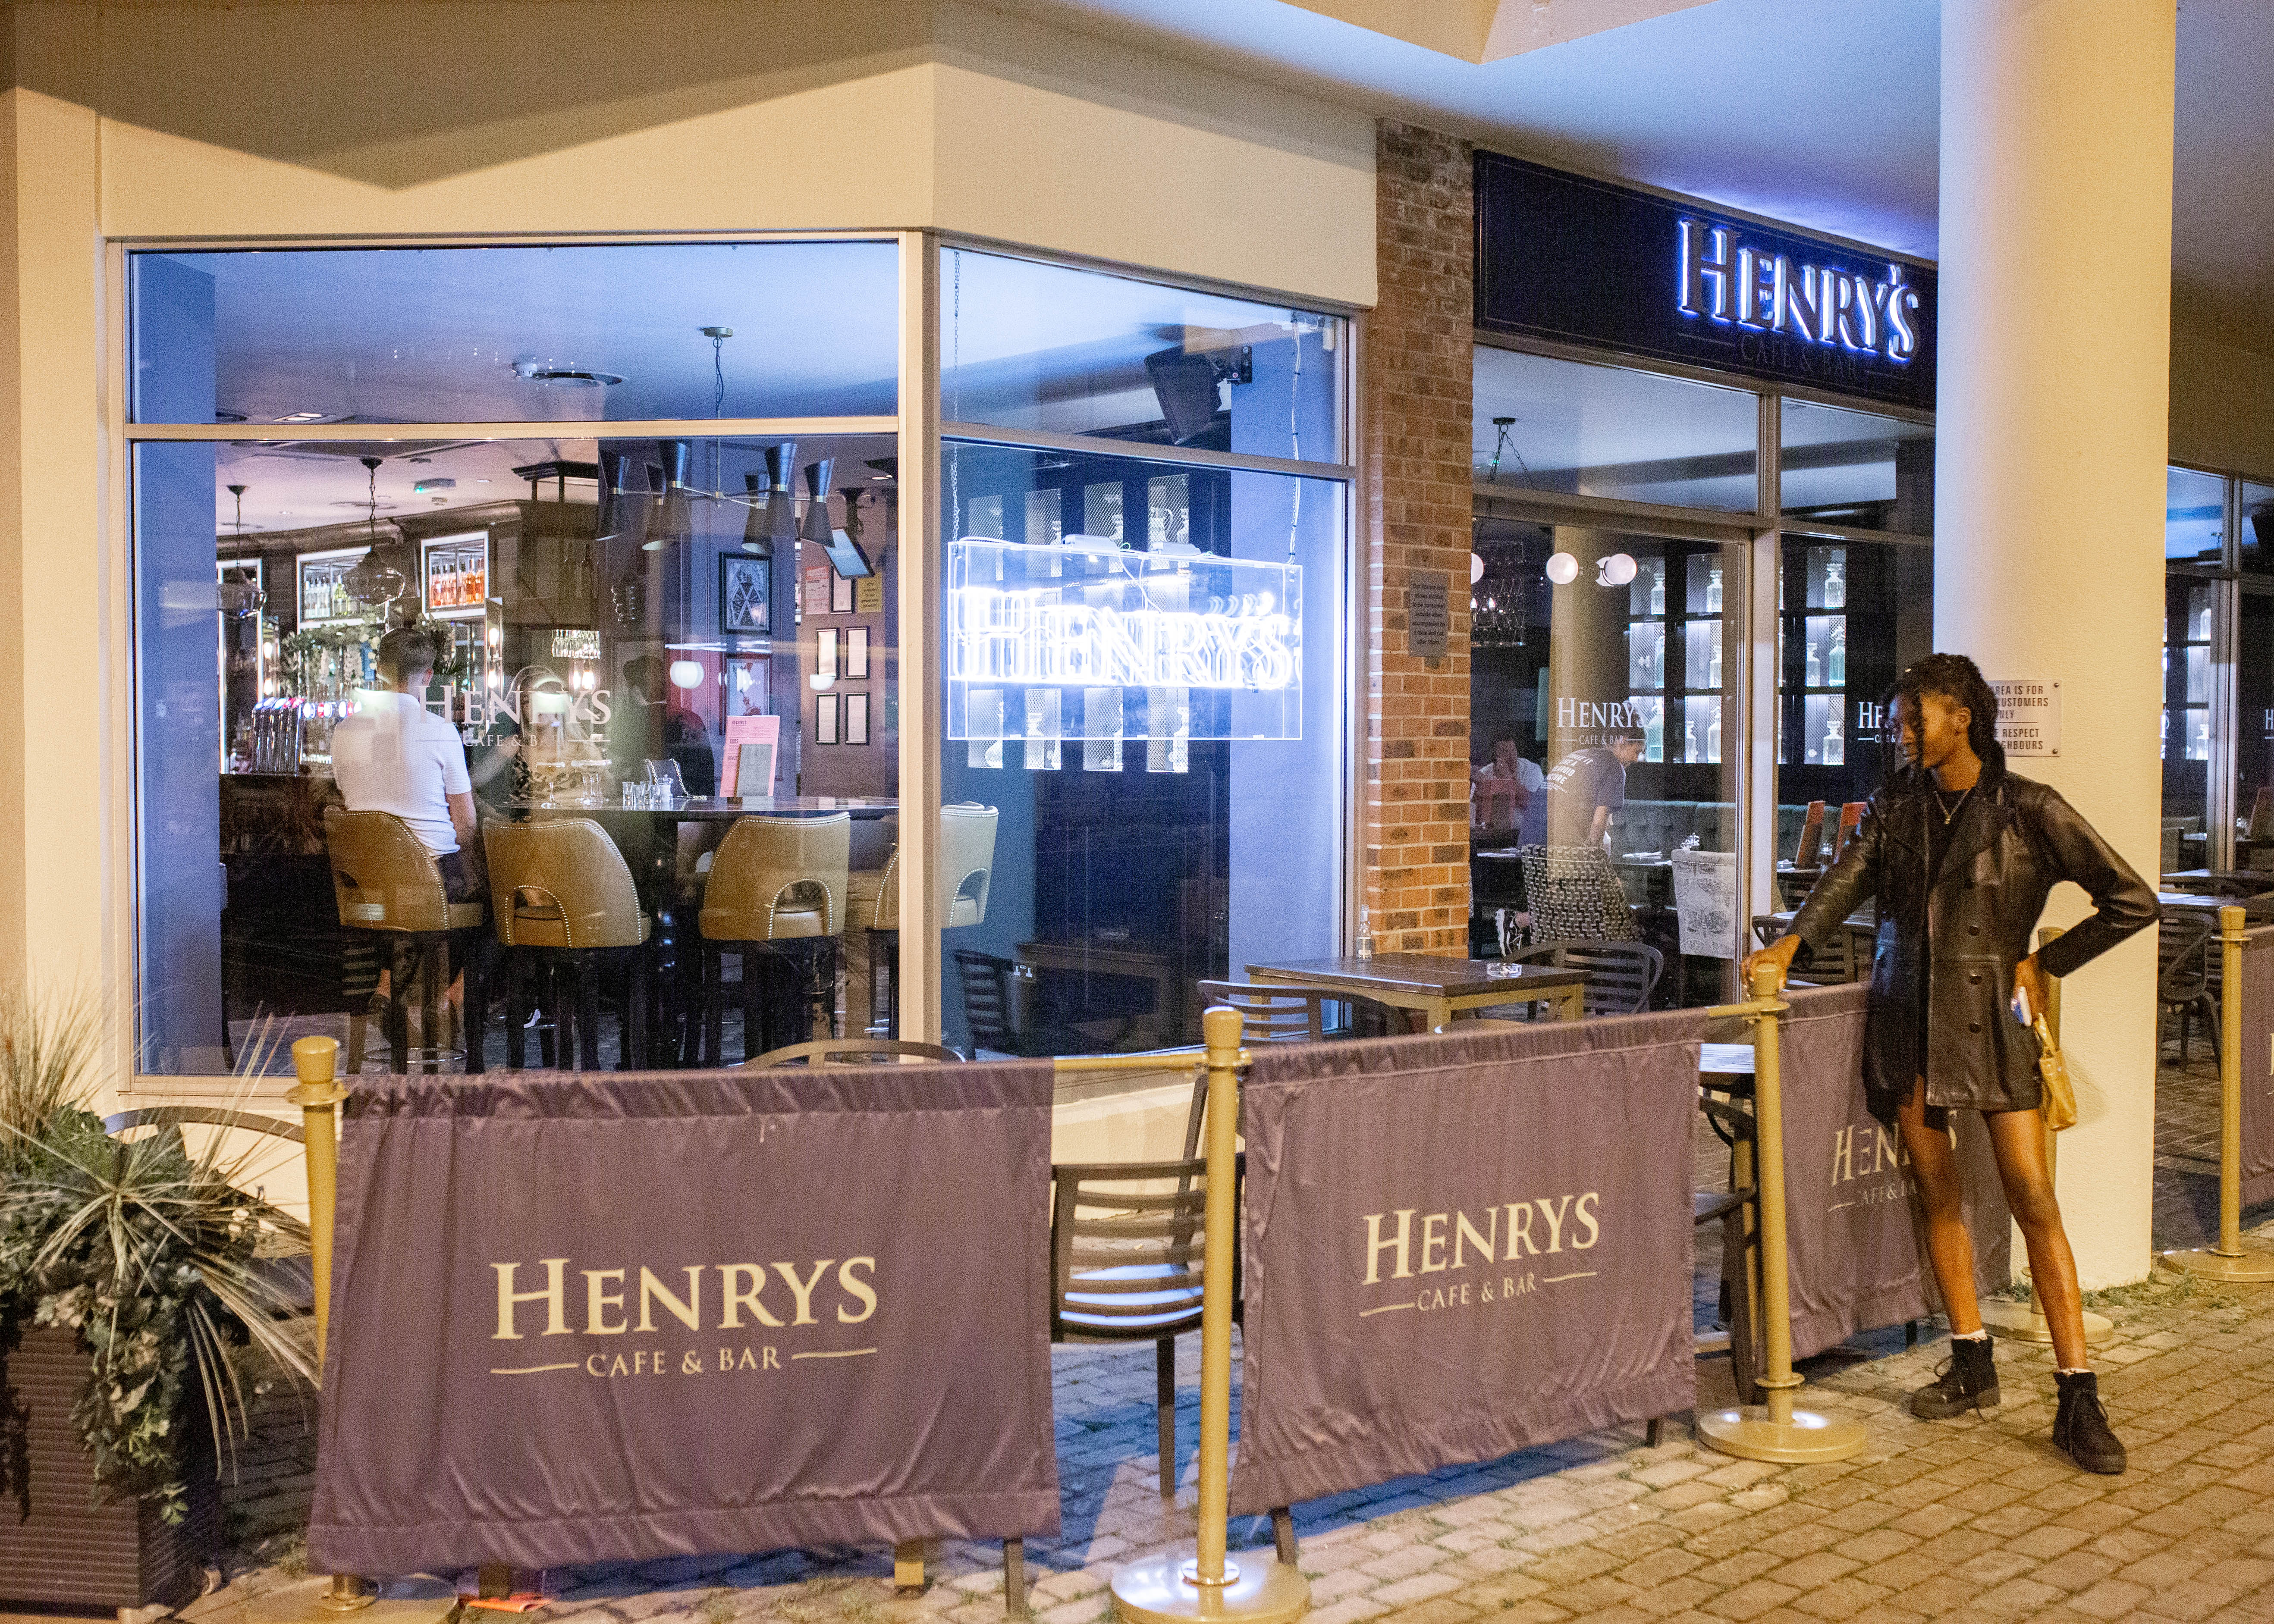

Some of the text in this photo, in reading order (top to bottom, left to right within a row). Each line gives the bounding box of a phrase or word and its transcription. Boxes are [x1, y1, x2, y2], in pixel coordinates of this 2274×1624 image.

[1679, 219, 1919, 361] HENRY'S
[2015, 686, 2023, 695] IS
[2027, 686, 2043, 695] FOR
[1579, 735, 1598, 745] CAFE
[2003, 729, 2039, 737] RESPECT
[1361, 1191, 1599, 1286] HENRYS
[489, 1256, 878, 1340] HENRYS
[1417, 1272, 1537, 1311] CAFE & BAR
[586, 1345, 782, 1378] CAFE & BAR
